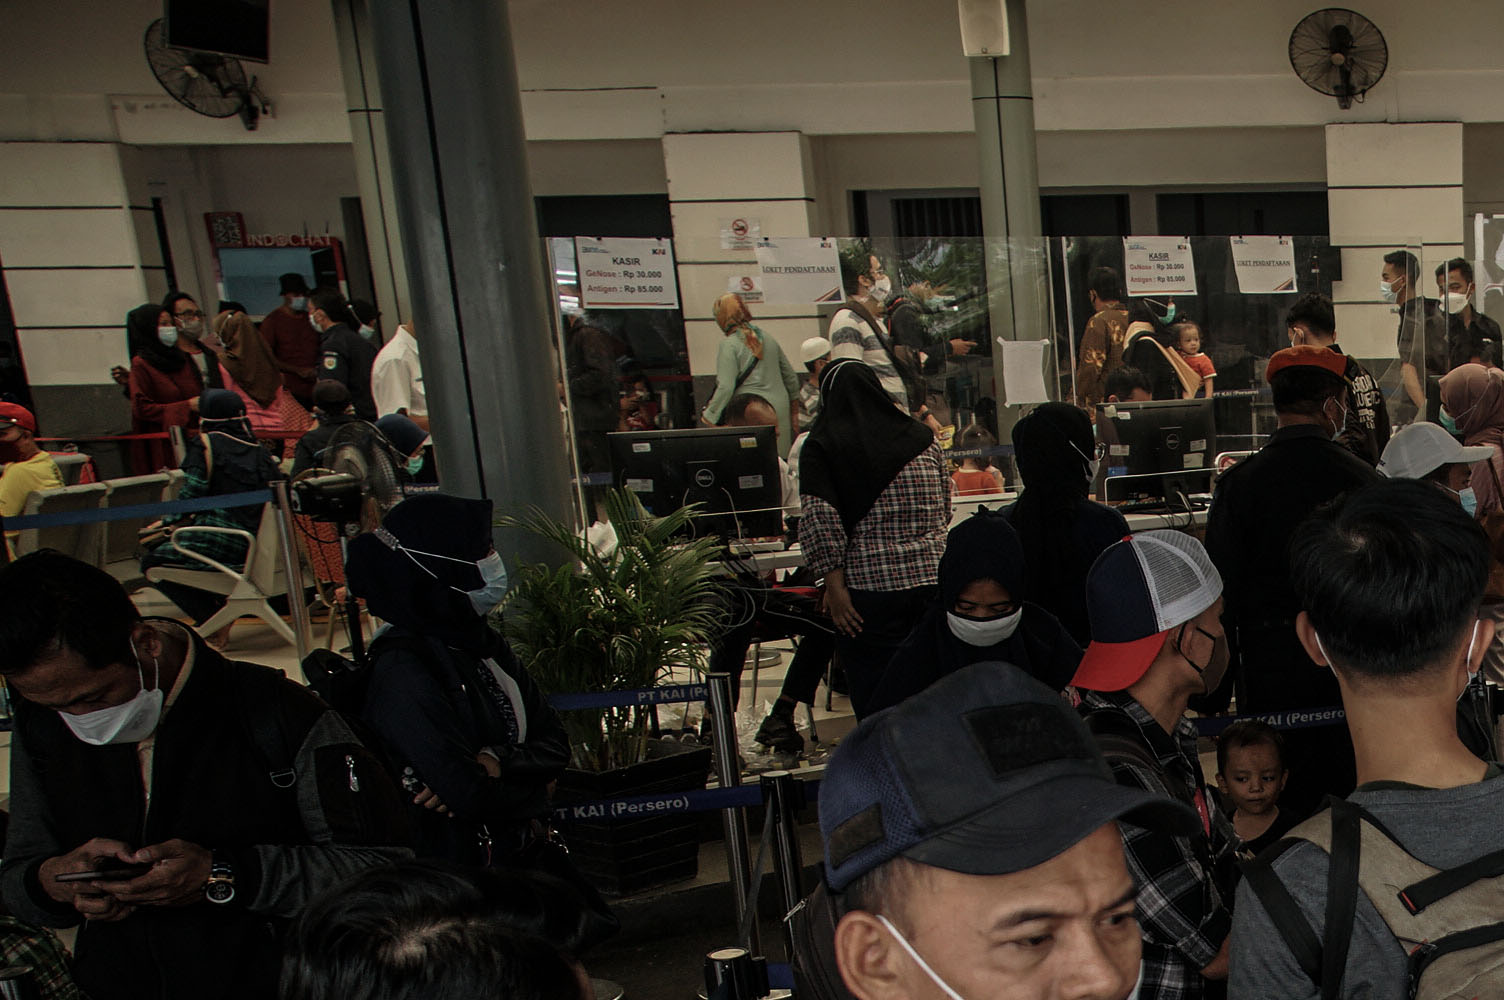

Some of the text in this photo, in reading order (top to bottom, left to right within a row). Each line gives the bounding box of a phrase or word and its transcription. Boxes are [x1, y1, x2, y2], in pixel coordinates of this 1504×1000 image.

[612, 257, 641, 265] KASIR
[586, 270, 616, 278] GeNose
[623, 270, 635, 279] Rp
[587, 285, 618, 294] Antigen
[624, 285, 636, 293] Rp
[659, 688, 685, 700] KAI
[1286, 708, 1346, 726] (Persero
[572, 804, 605, 819] KAI
[610, 796, 689, 817] (Persero)
